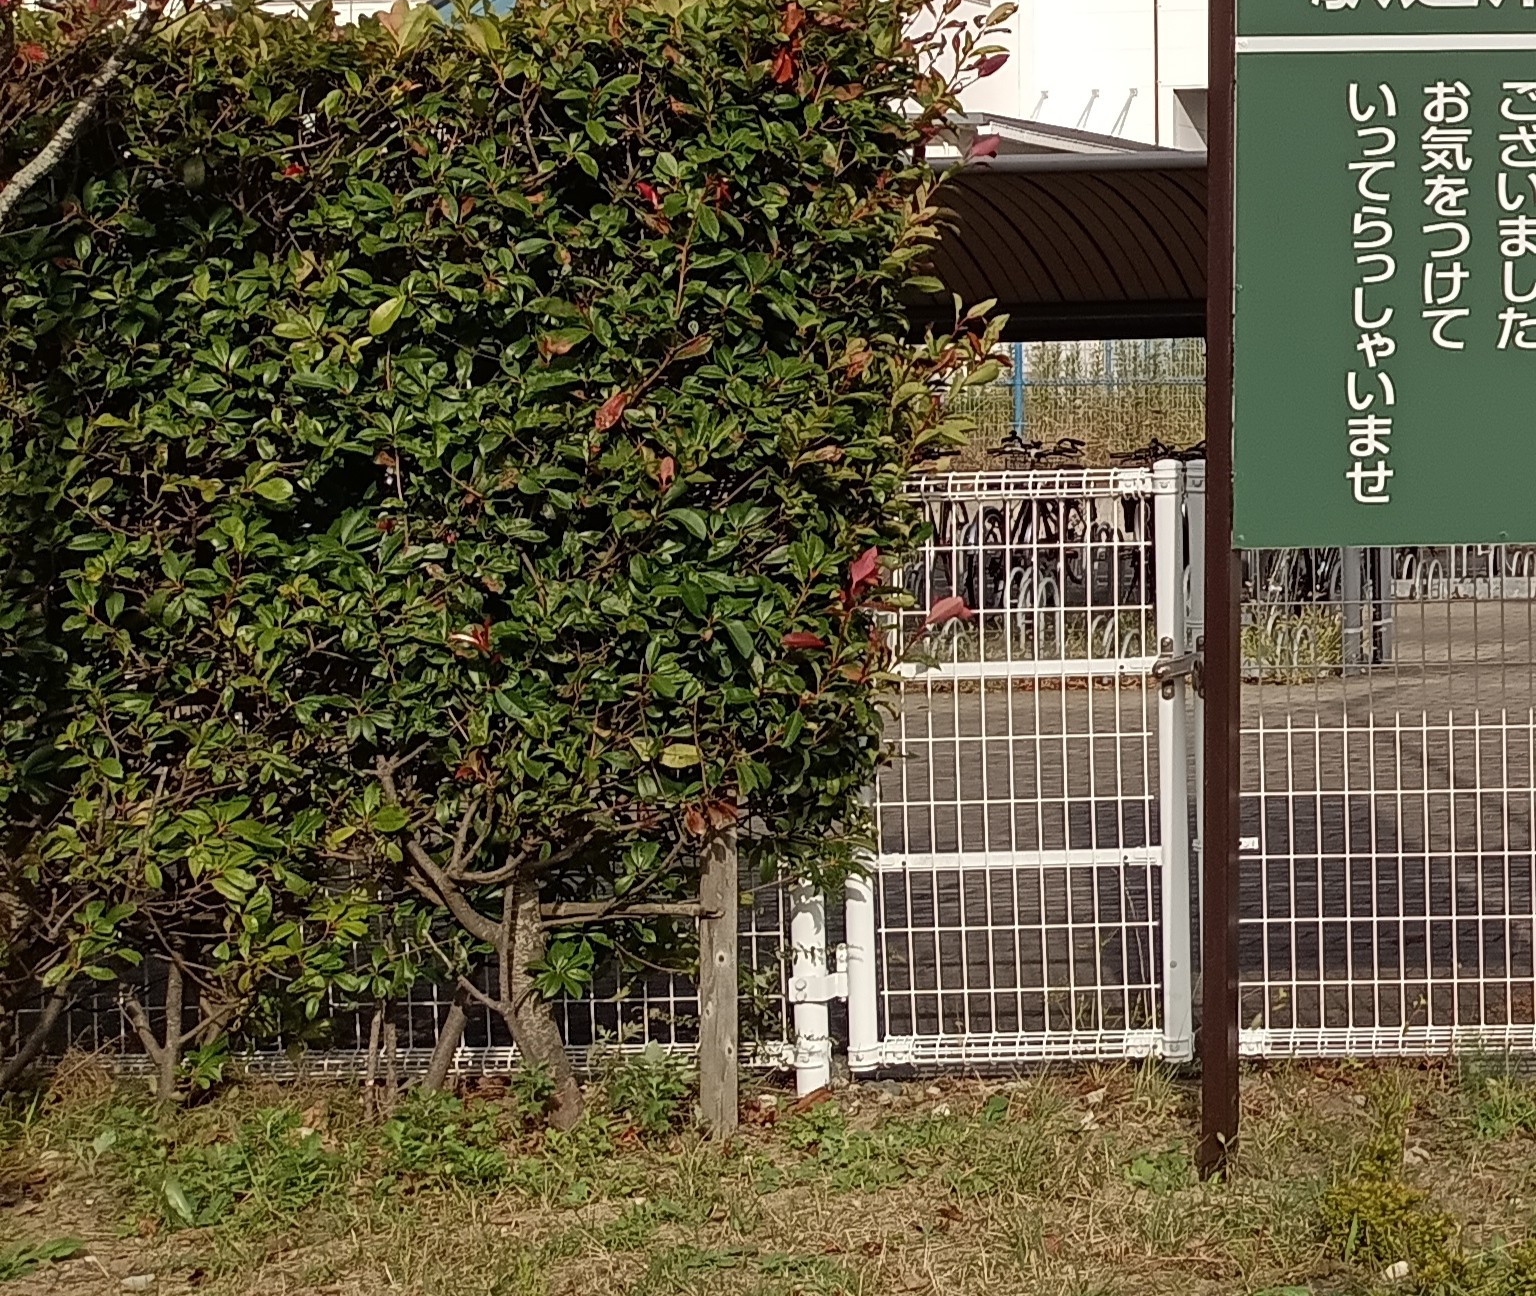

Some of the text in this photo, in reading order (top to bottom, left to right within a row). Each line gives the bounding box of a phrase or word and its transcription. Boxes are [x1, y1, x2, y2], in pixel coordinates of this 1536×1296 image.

[1345, 82, 1397, 505] いってらっしゃいませ
[1420, 80, 1473, 350] お気をつけて
